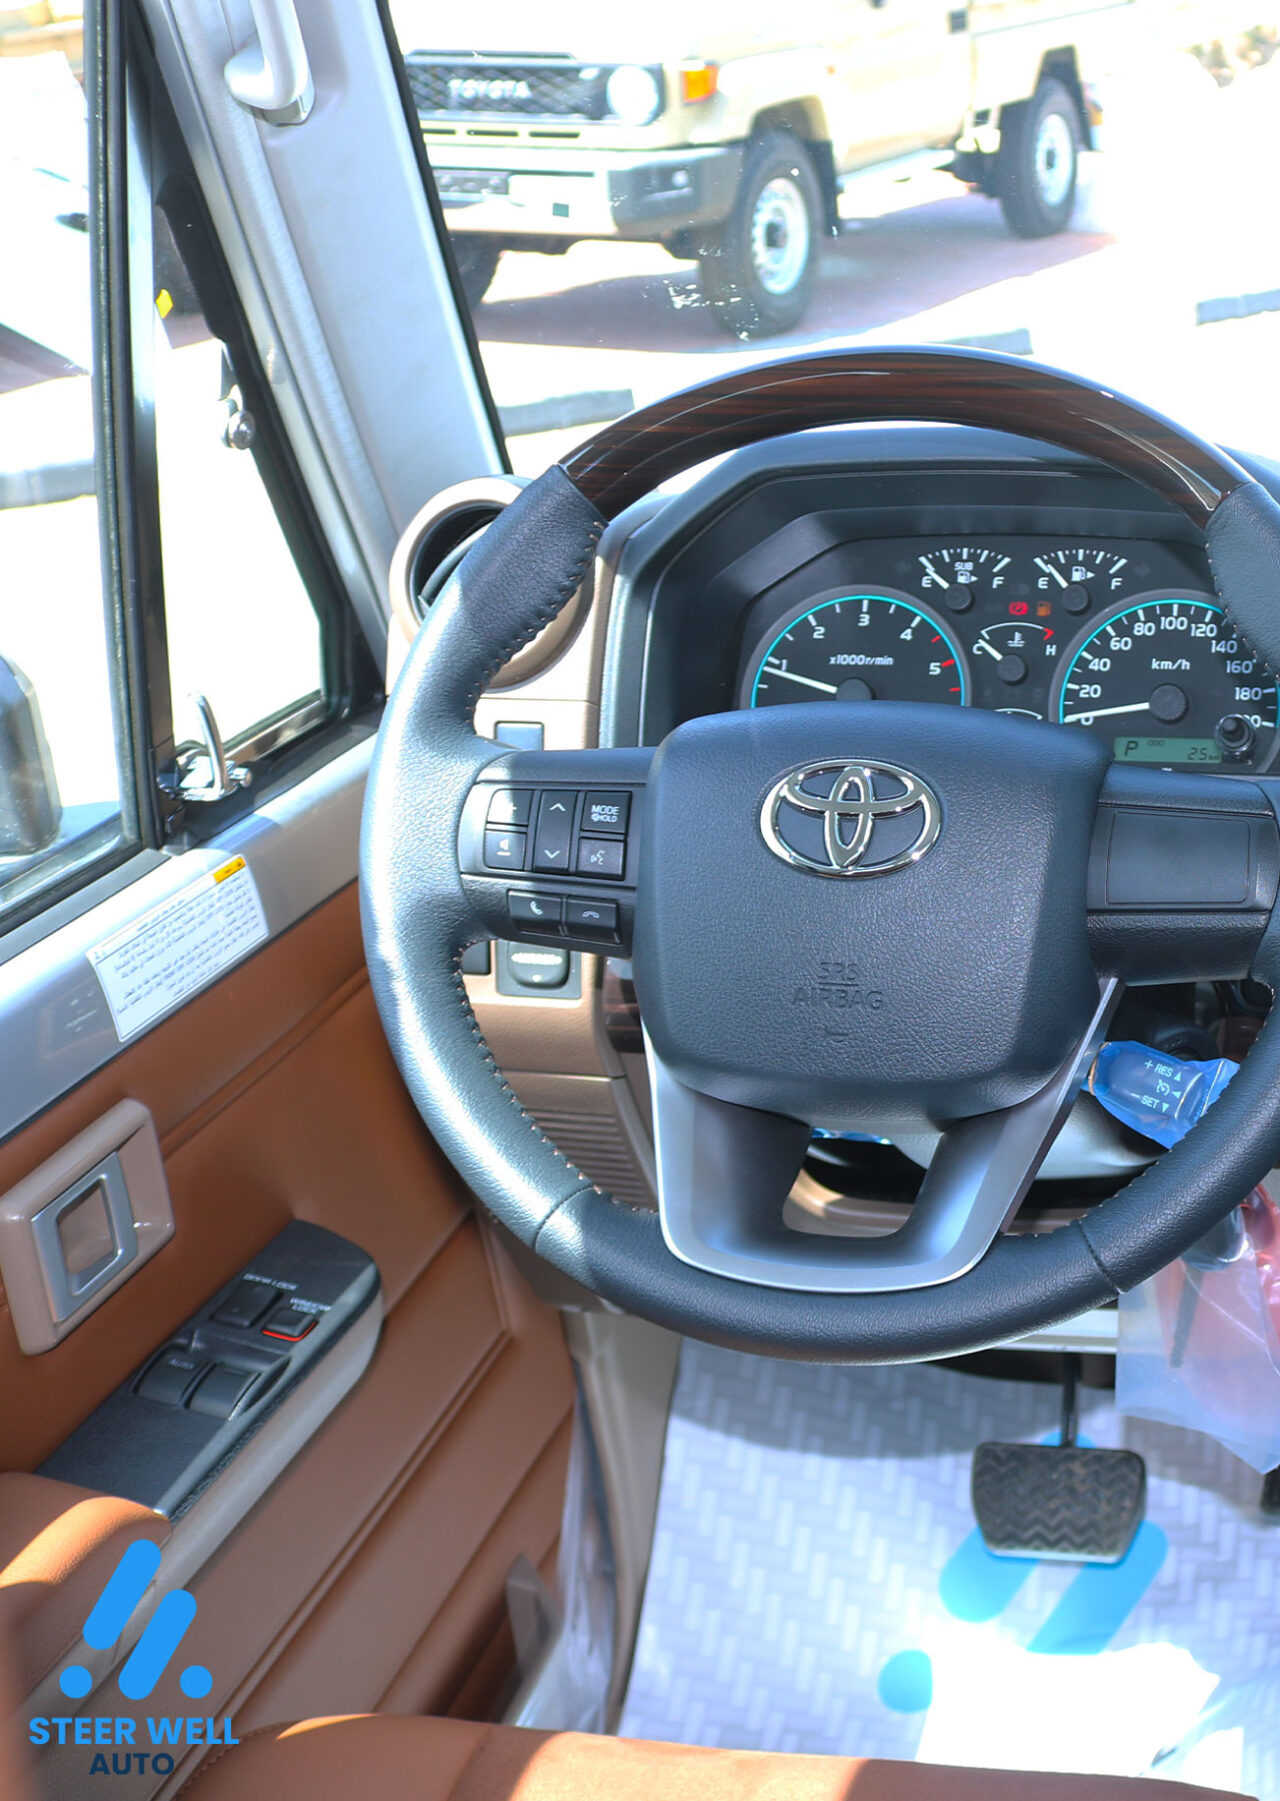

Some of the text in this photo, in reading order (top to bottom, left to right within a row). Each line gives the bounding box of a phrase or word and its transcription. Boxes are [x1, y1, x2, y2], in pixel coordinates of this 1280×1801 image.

[448, 78, 532, 99] TOYOTA
[954, 562, 974, 571] SUB
[921, 576, 932, 588] E
[992, 576, 1005, 589] F
[1038, 577, 1049, 589] E
[1111, 577, 1123, 590] F
[857, 614, 870, 627] 3
[1160, 616, 1188, 630] 100
[812, 626, 826, 639] 2
[899, 628, 913, 641] 4
[1133, 622, 1156, 636] 80
[1190, 624, 1217, 637] 120
[1045, 645, 1057, 656] H
[1110, 637, 1132, 651] 60
[1211, 640, 1238, 654] 140
[780, 659, 788, 672] 1
[829, 654, 894, 666] x1000r/min
[1088, 658, 1111, 672] 40
[1151, 658, 1191, 671] km/h
[929, 663, 941, 676] 5
[1226, 660, 1253, 674] 160
[1079, 684, 1101, 698] 20
[1235, 687, 1262, 701] 180
[1125, 740, 1138, 757] P
[1188, 747, 1207, 761] 25
[591, 804, 620, 815] MODE
[1154, 1063, 1174, 1077] RES
[1140, 1094, 1160, 1109] SET
